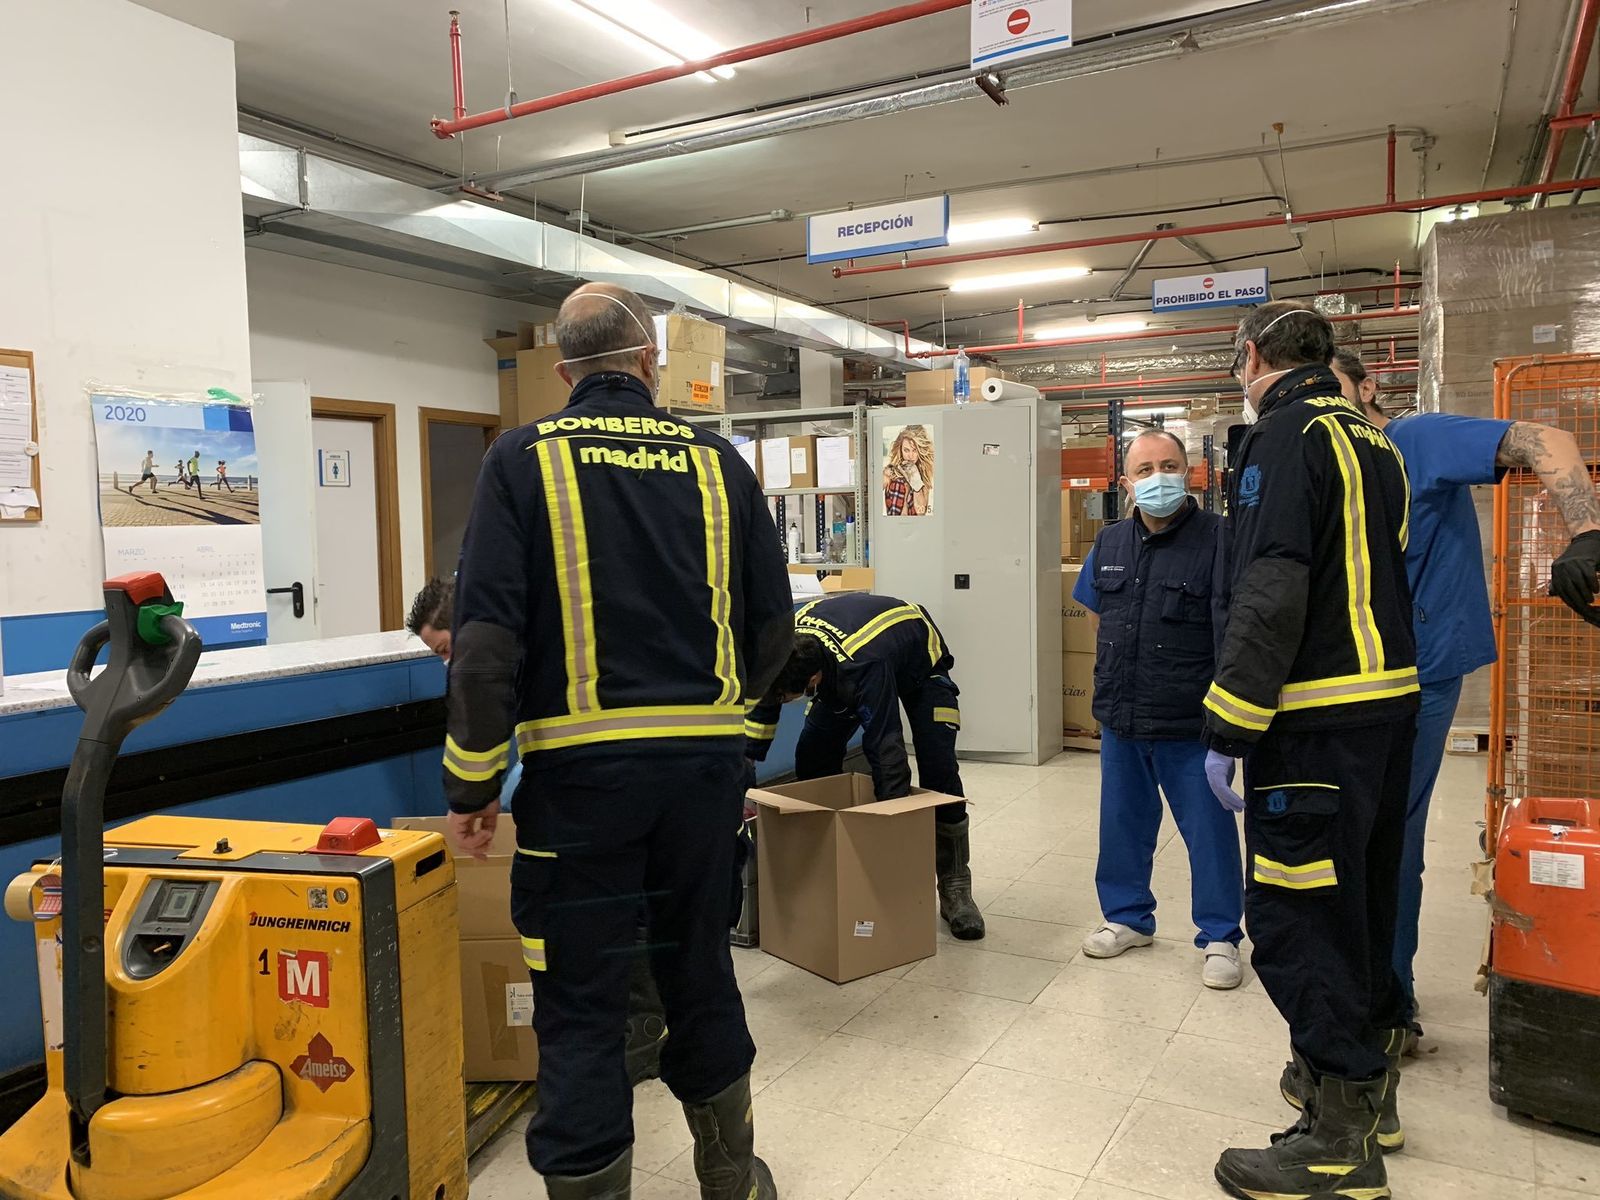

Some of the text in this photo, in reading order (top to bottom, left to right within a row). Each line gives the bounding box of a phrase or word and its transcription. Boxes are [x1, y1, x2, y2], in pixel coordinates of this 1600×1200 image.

[837, 214, 914, 238] RECEPCIÓN
[1156, 286, 1264, 306] PROHIBIDO EL PASO
[104, 404, 146, 423] 2020
[1303, 396, 1364, 417] BOMB
[536, 417, 696, 440] BOMBEROS
[579, 446, 689, 473] madrid
[117, 548, 146, 557] MARZO
[230, 620, 262, 630] Medtronic
[799, 615, 848, 639] madrid
[249, 912, 351, 932] JUNGHEINRICH
[258, 948, 270, 975] 1
[286, 959, 321, 997] M
[299, 1057, 347, 1080] Ameise
